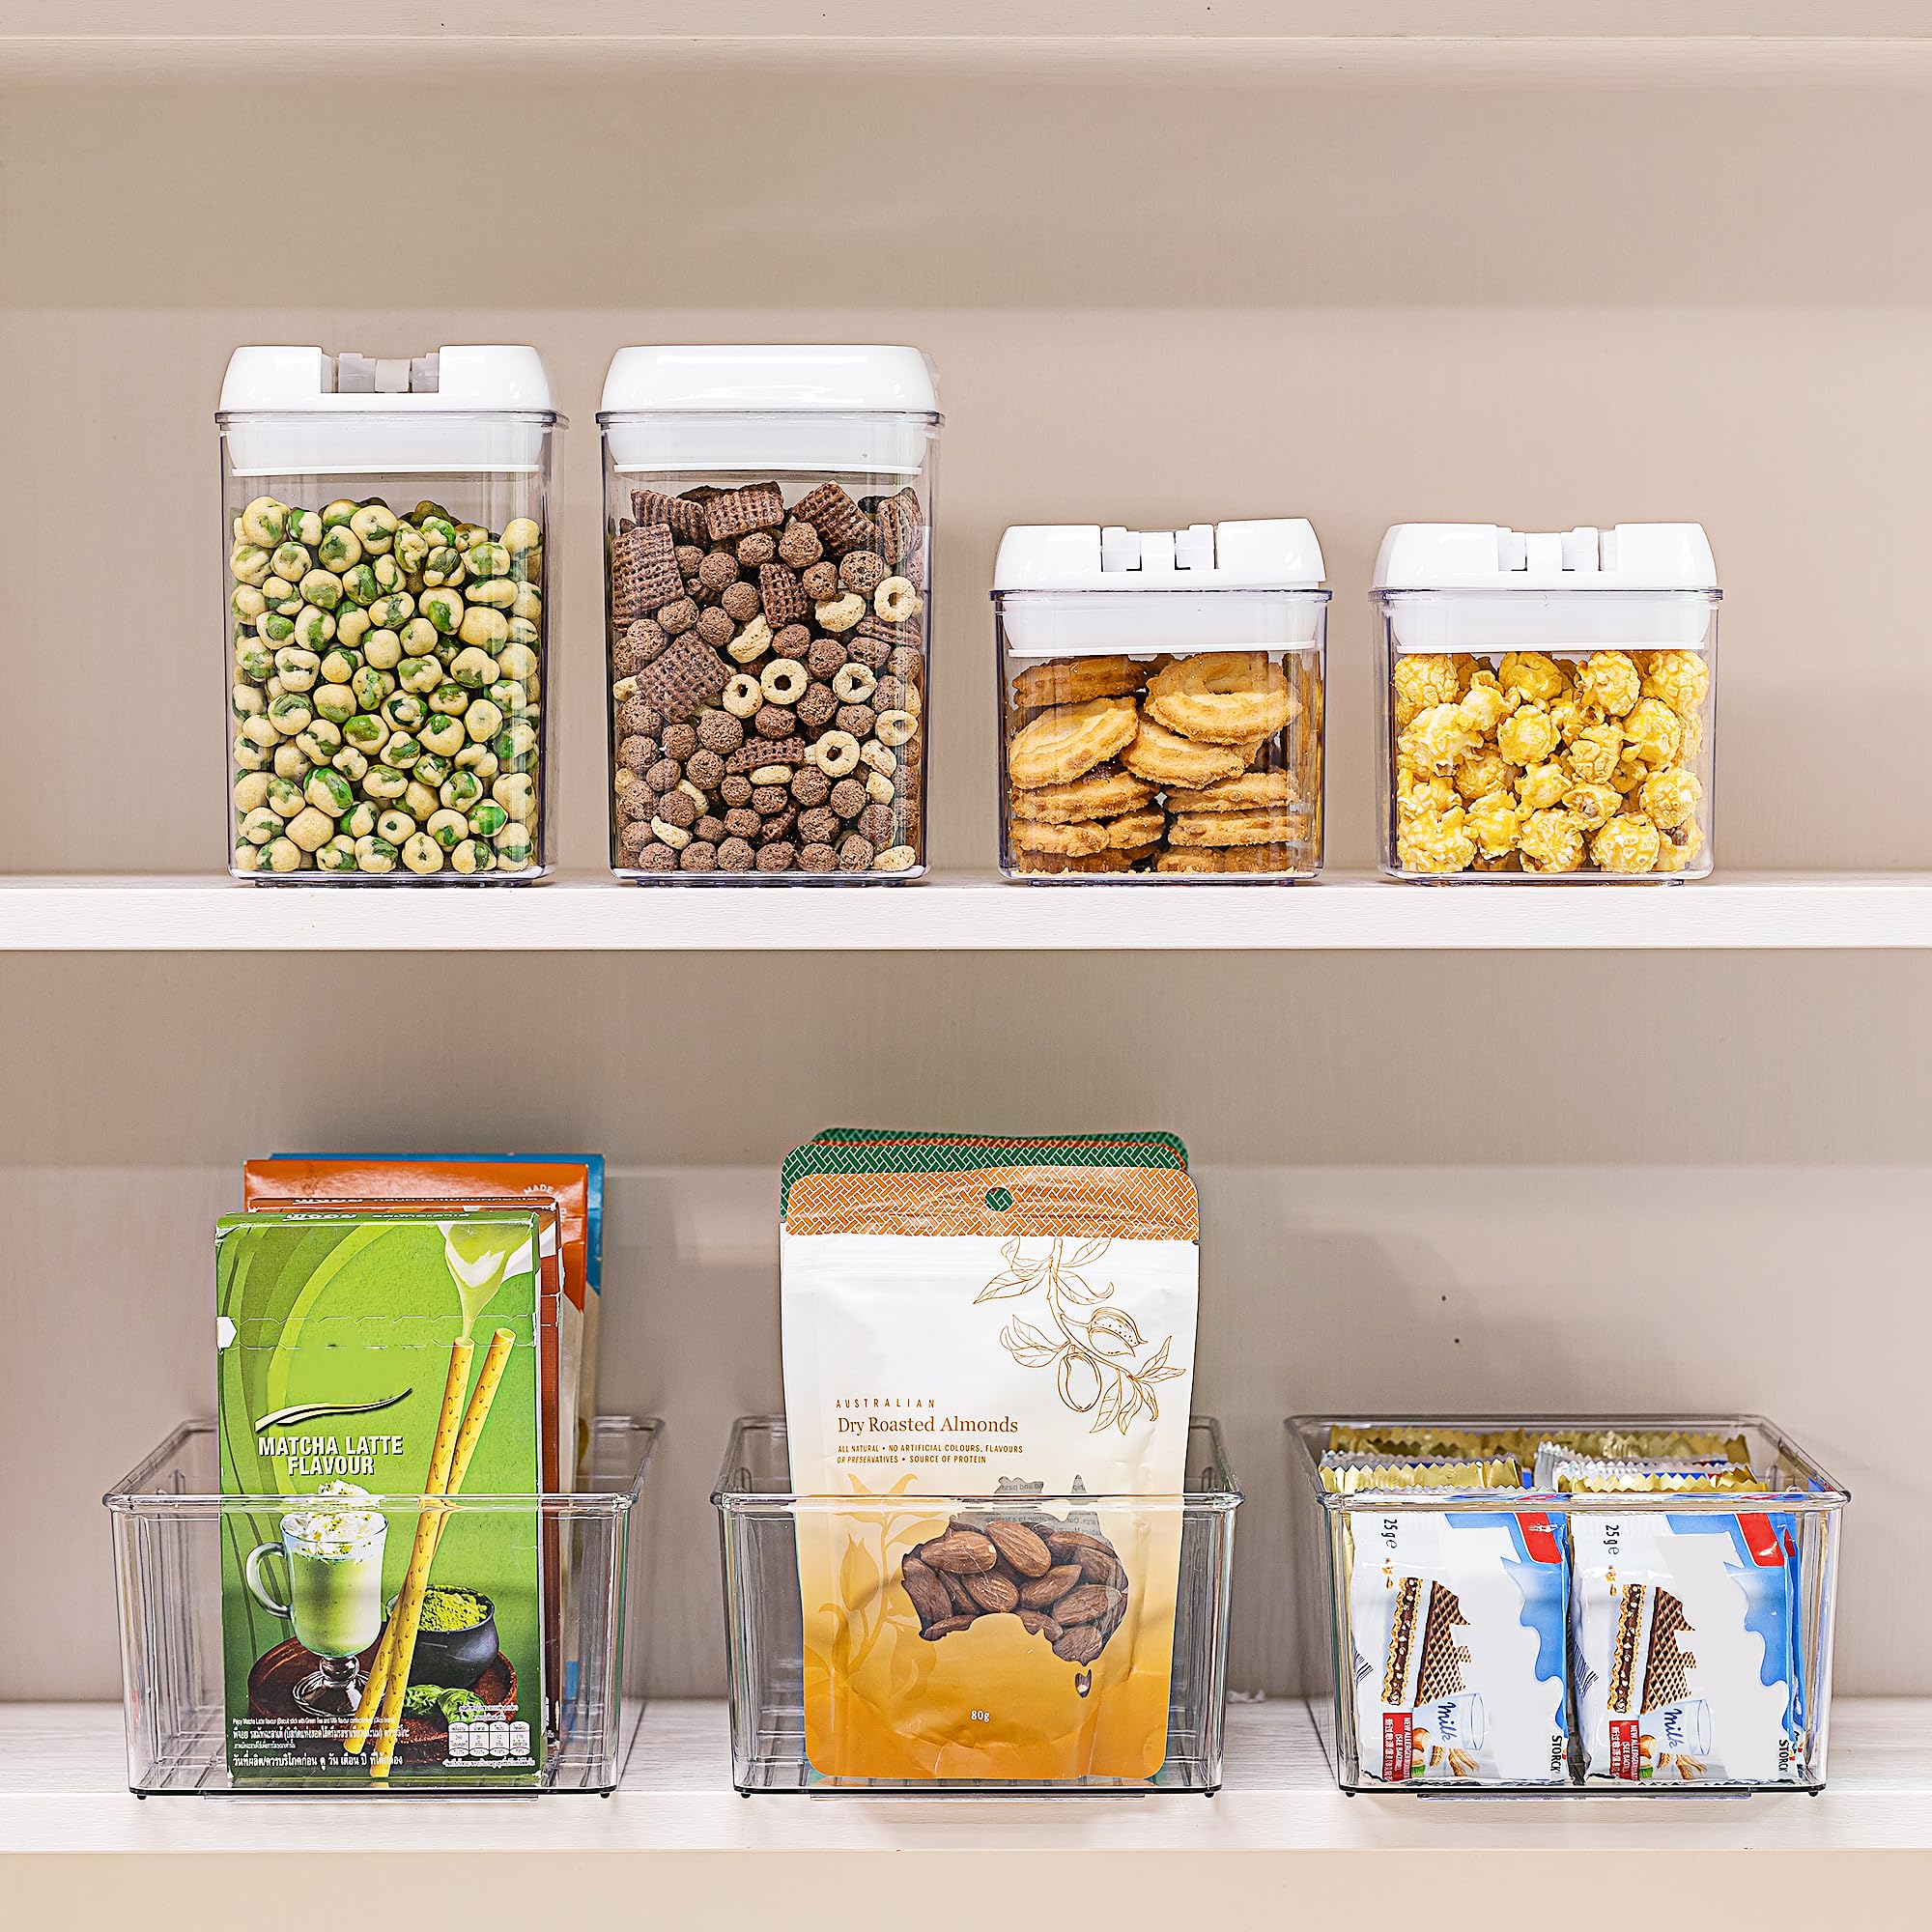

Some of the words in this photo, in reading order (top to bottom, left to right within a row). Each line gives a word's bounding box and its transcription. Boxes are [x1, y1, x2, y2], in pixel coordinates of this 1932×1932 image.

[836, 1398, 935, 1408] AUSTRALIAN
[838, 1417, 865, 1436] Dry
[868, 1416, 936, 1433] Roasted
[940, 1415, 1019, 1433] Almonds
[258, 1436, 340, 1457] MATCHA
[346, 1435, 404, 1456] LATTE
[985, 1444, 1023, 1454] FLAVOURS
[288, 1456, 375, 1476] FLAVOUR
[909, 1455, 939, 1463] SOURCE
[971, 1710, 990, 1723] 80g
[1630, 1725, 1638, 1739] NEW
[1549, 1735, 1563, 1774] STORCK
[1778, 1739, 1790, 1772] STORCK
